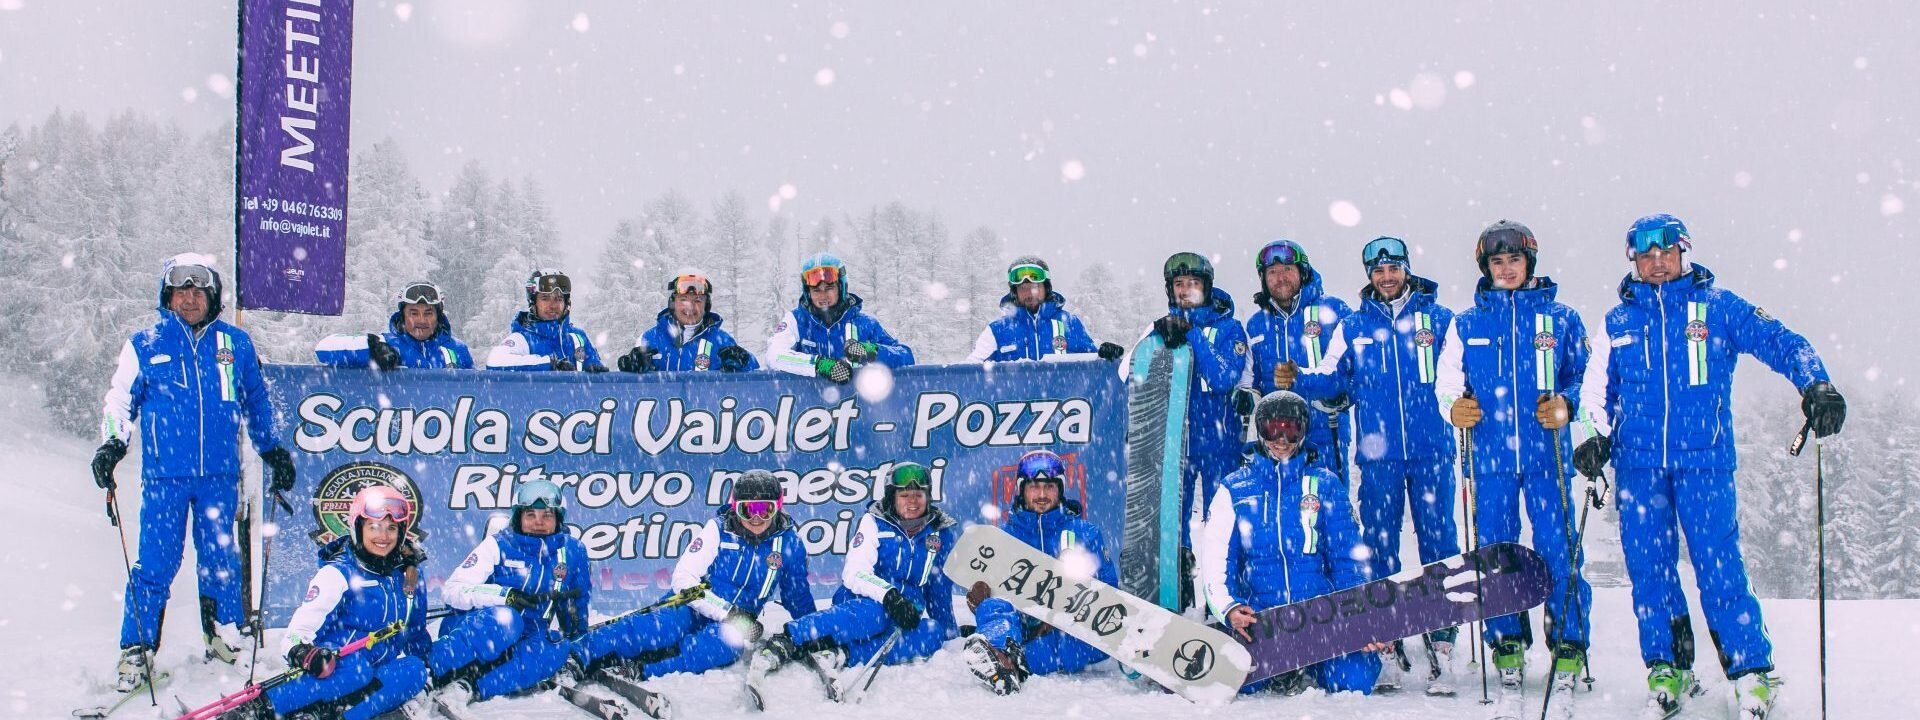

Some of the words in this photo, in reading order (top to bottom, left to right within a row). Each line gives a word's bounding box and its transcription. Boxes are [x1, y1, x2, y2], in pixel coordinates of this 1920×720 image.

[280, 0, 321, 173] MEETI
[243, 196, 259, 210] Tel
[261, 198, 279, 212] +39
[281, 199, 307, 217] 0462
[308, 204, 343, 221] 763309
[259, 216, 331, 239] info@vajolet.it
[293, 392, 511, 455] Scuola
[521, 397, 619, 455] sci
[631, 394, 861, 456] Vajolet
[910, 390, 1093, 449] Pozza
[324, 471, 357, 499] SCUOLA
[355, 468, 400, 484] ITALIAN
